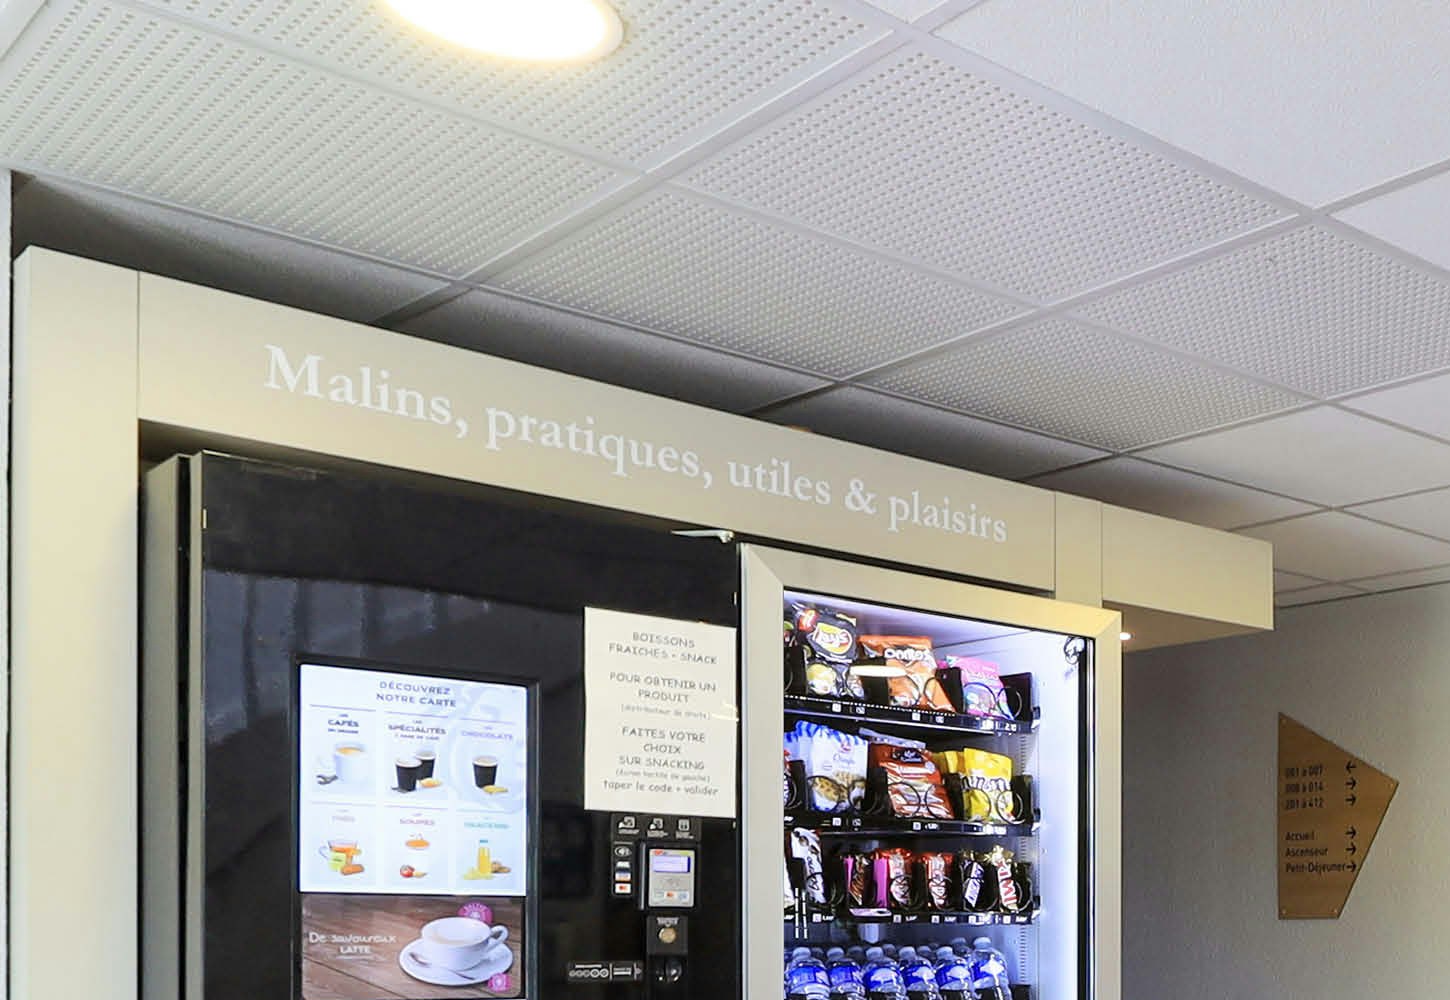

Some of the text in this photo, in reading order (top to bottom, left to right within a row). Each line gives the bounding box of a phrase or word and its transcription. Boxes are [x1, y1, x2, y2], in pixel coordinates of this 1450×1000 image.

[264, 343, 1007, 542] Malins, pratiques, utiles & plaisirs
[632, 632, 696, 649] BOISSONS
[680, 652, 718, 665] SNACK
[379, 680, 451, 696] DÉCOUVREZ
[609, 672, 717, 693] POUR OBTENIR UN
[376, 693, 457, 708] NOTRE CARTE
[637, 689, 689, 704] PRODUIT
[622, 726, 705, 743] FAITES VOTRE
[643, 743, 681, 755] CHOIX
[618, 755, 705, 771] SUR SNACKING
[648, 783, 673, 793] code
[684, 786, 719, 797] valider
[1285, 830, 1315, 841] Accueil
[1285, 846, 1329, 857] Ascenseur
